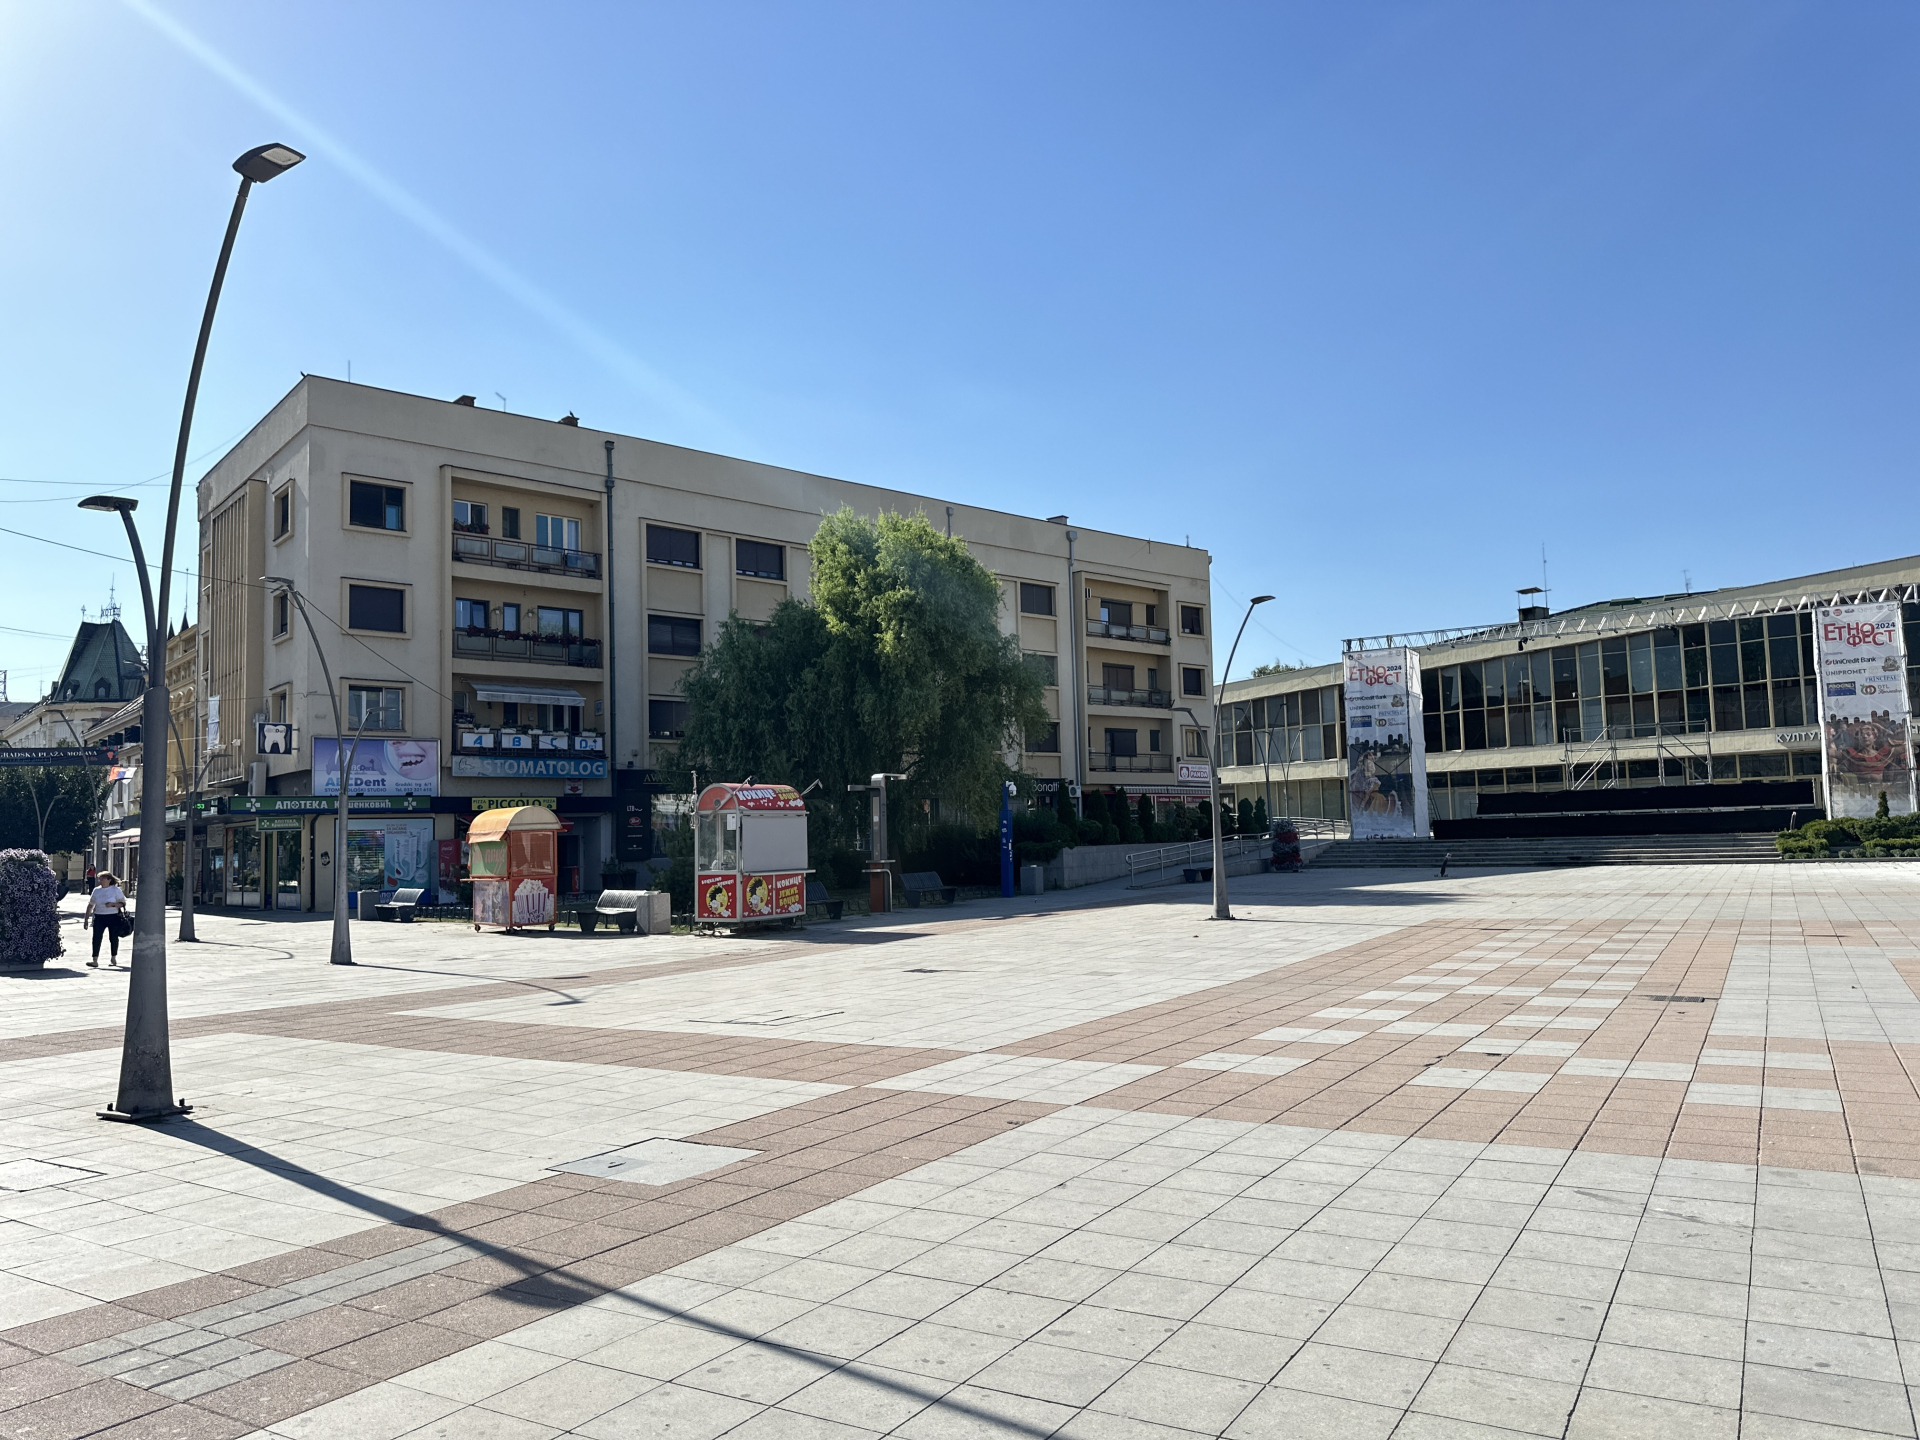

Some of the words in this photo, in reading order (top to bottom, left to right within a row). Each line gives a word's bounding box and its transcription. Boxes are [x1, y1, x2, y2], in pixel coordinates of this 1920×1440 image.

[1847, 629, 1895, 647] ФЕСТ
[1833, 657, 1860, 665] UniCredit
[473, 735, 483, 746] A
[512, 736, 522, 747] B
[482, 759, 604, 775] STOMATOLOG
[1190, 770, 1208, 779] PANDA
[736, 788, 777, 801] КОКИЦЕ
[275, 800, 328, 810] АПОТЕКА
[334, 799, 392, 809] Кшенковић
[488, 799, 542, 809] PICCOLO
[776, 875, 802, 889] КОКИЦЕ
